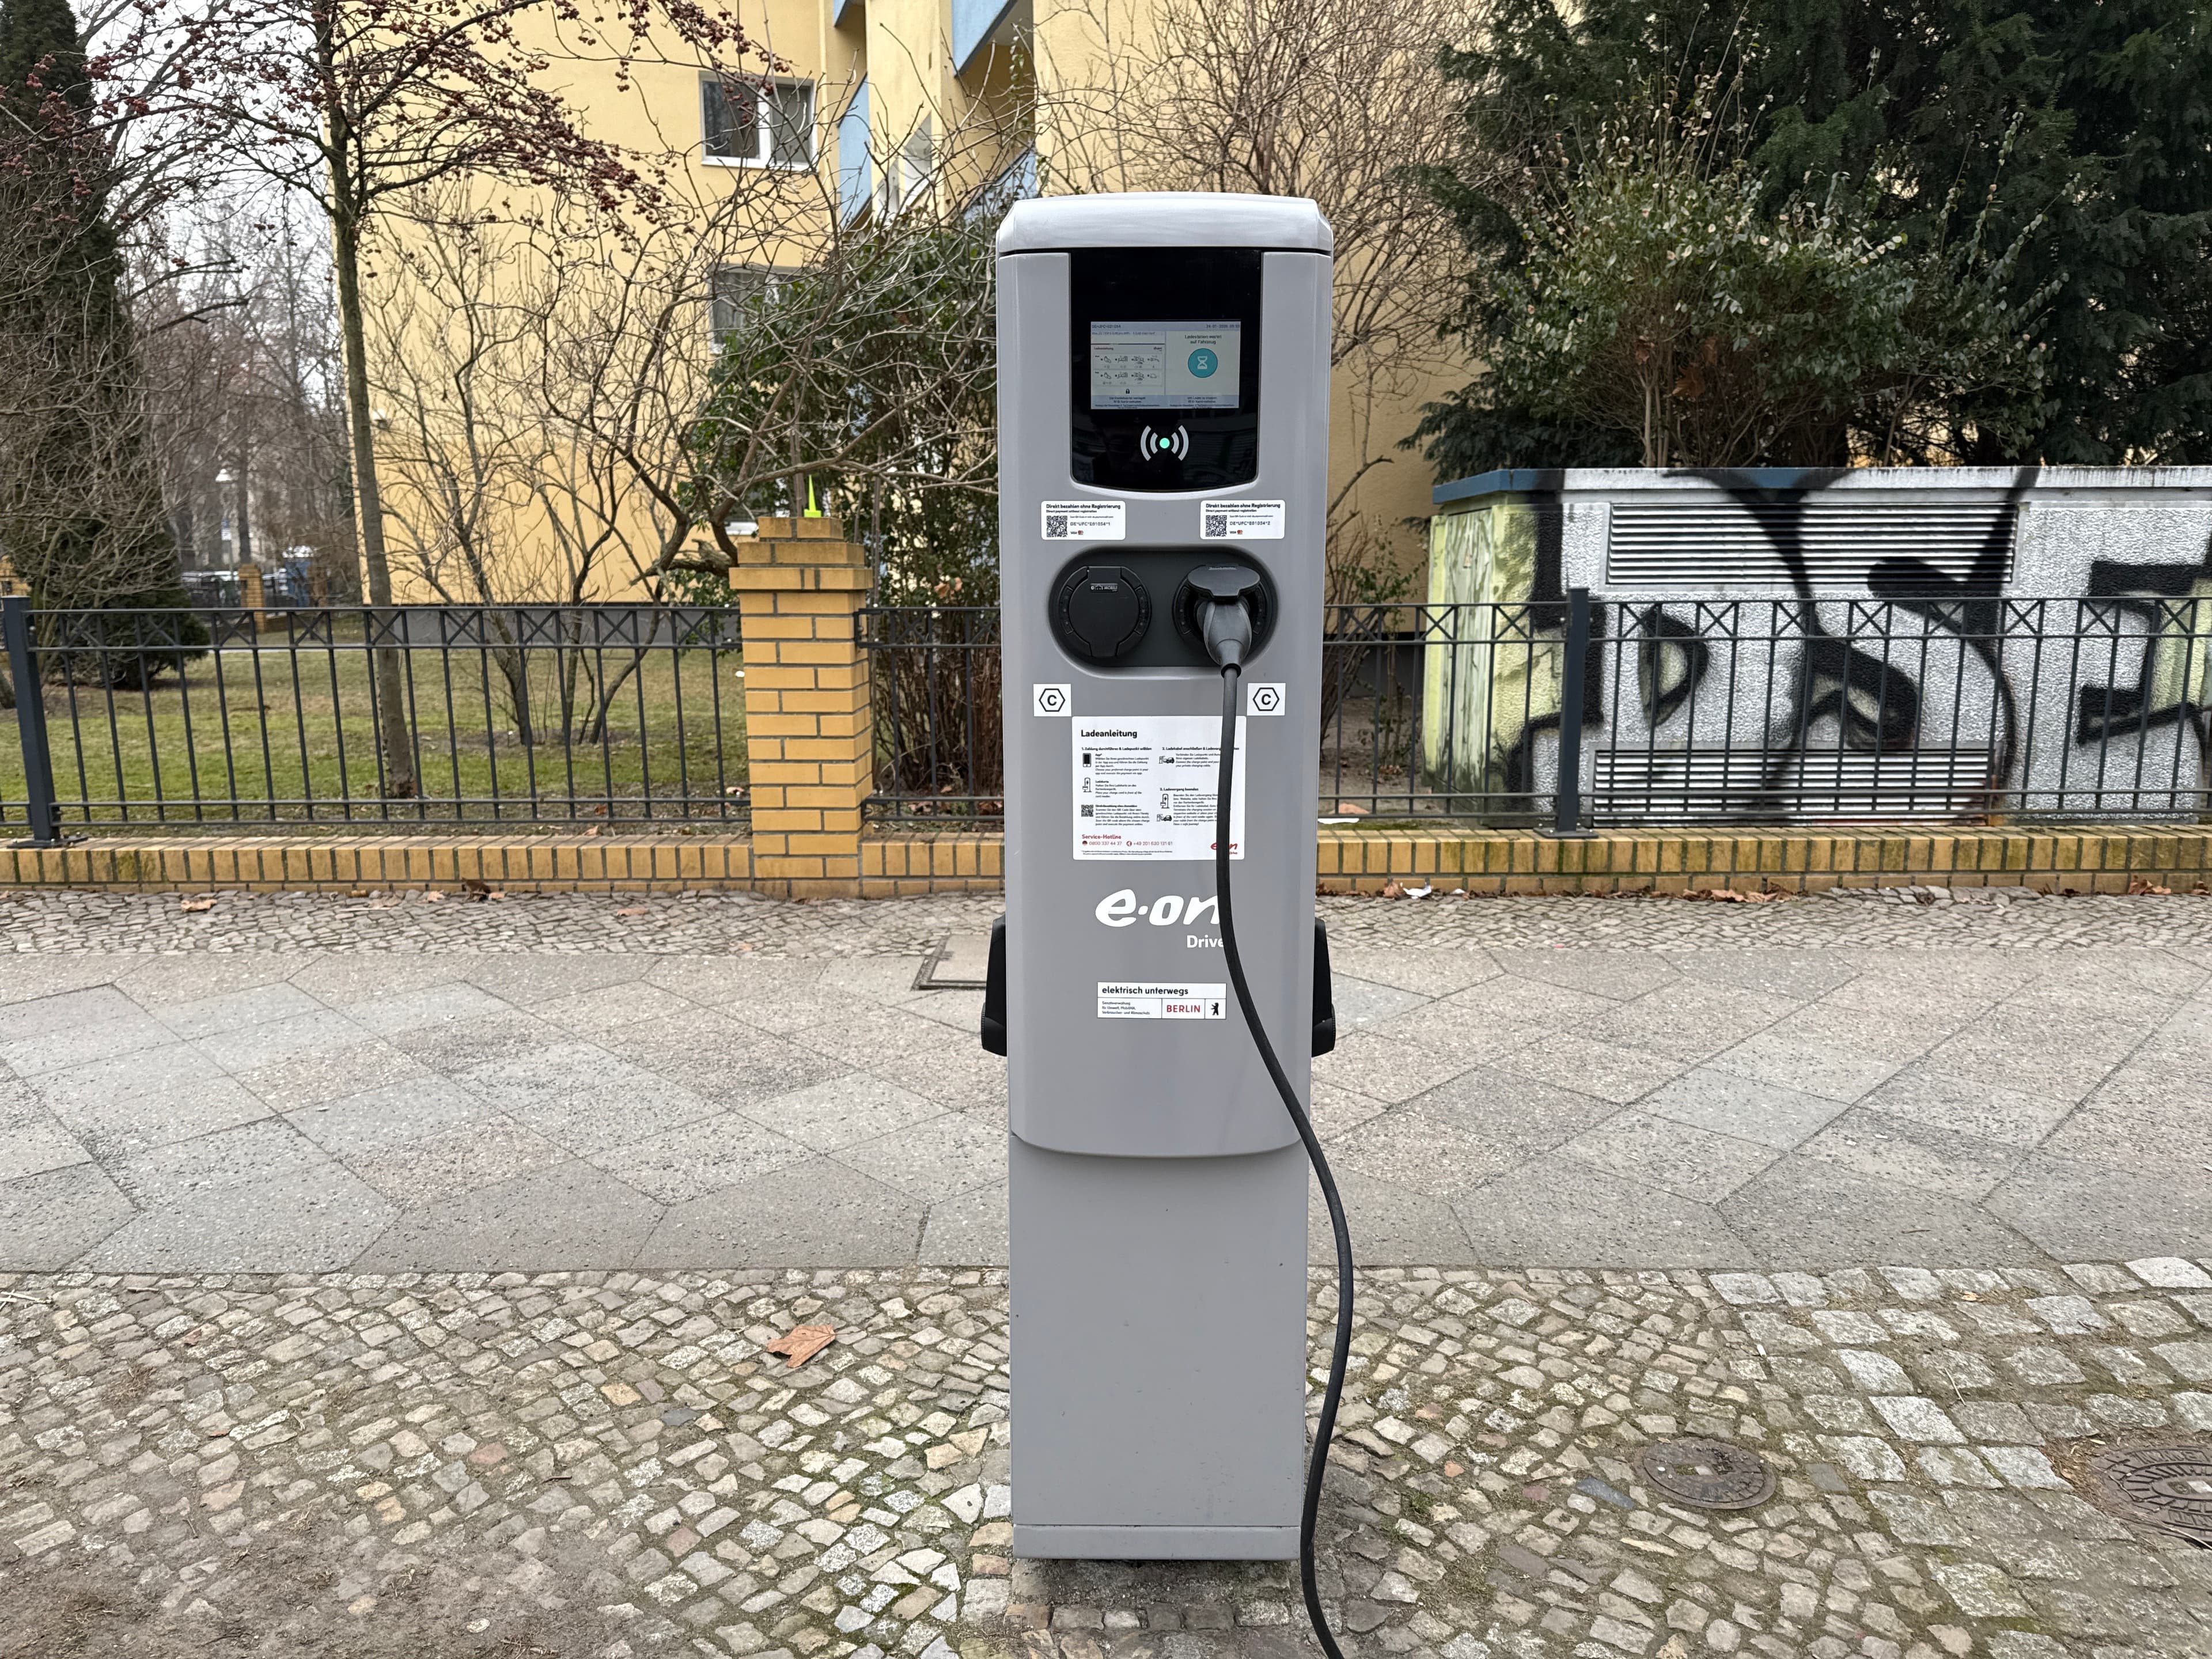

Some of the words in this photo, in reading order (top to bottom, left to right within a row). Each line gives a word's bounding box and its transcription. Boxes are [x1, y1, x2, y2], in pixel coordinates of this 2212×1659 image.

[1047, 695, 1056, 706] C
[1262, 694, 1271, 705] C
[1081, 729, 1137, 738] Ladeanleitung
[1187, 935, 1224, 948] Drive
[1102, 986, 1142, 994] elektrisch
[1145, 987, 1188, 996] unterwegs
